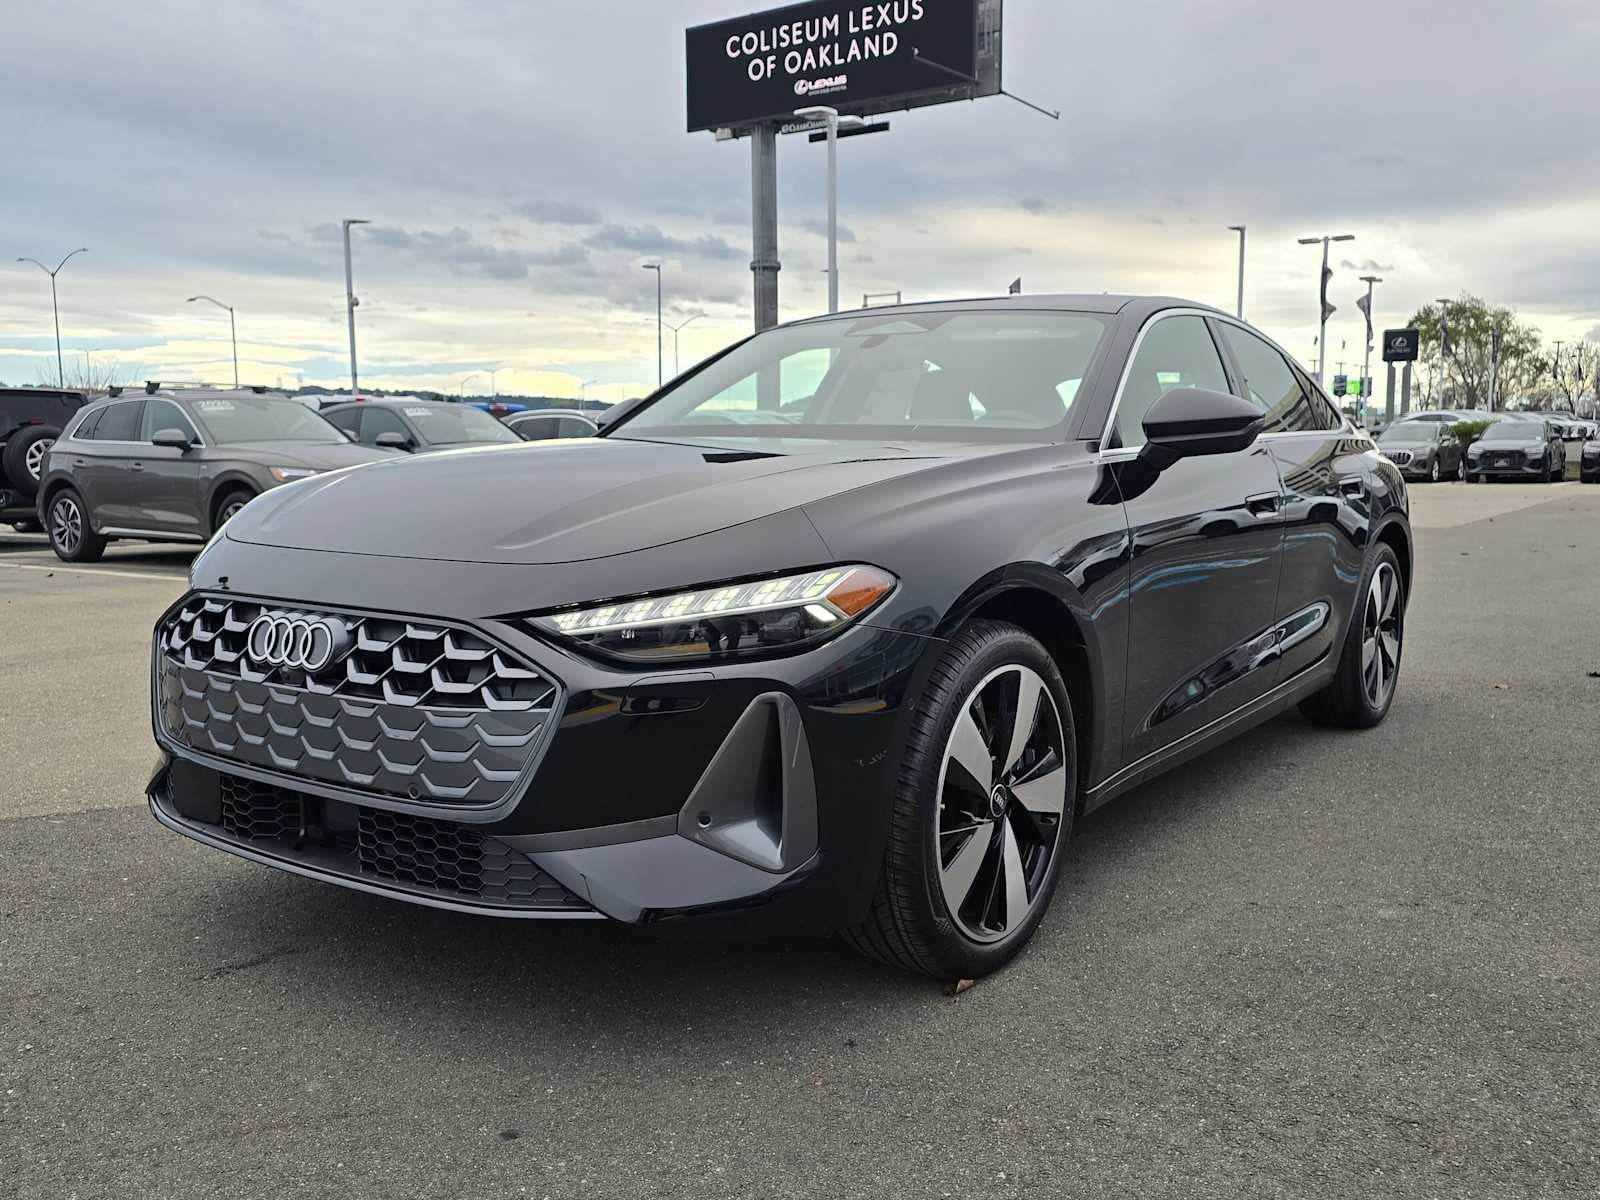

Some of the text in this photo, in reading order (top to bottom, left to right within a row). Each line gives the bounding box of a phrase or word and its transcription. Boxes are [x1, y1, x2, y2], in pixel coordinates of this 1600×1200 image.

[726, 0, 924, 58] COLISEUM LEXUS
[748, 32, 898, 81] OF OAKLAND
